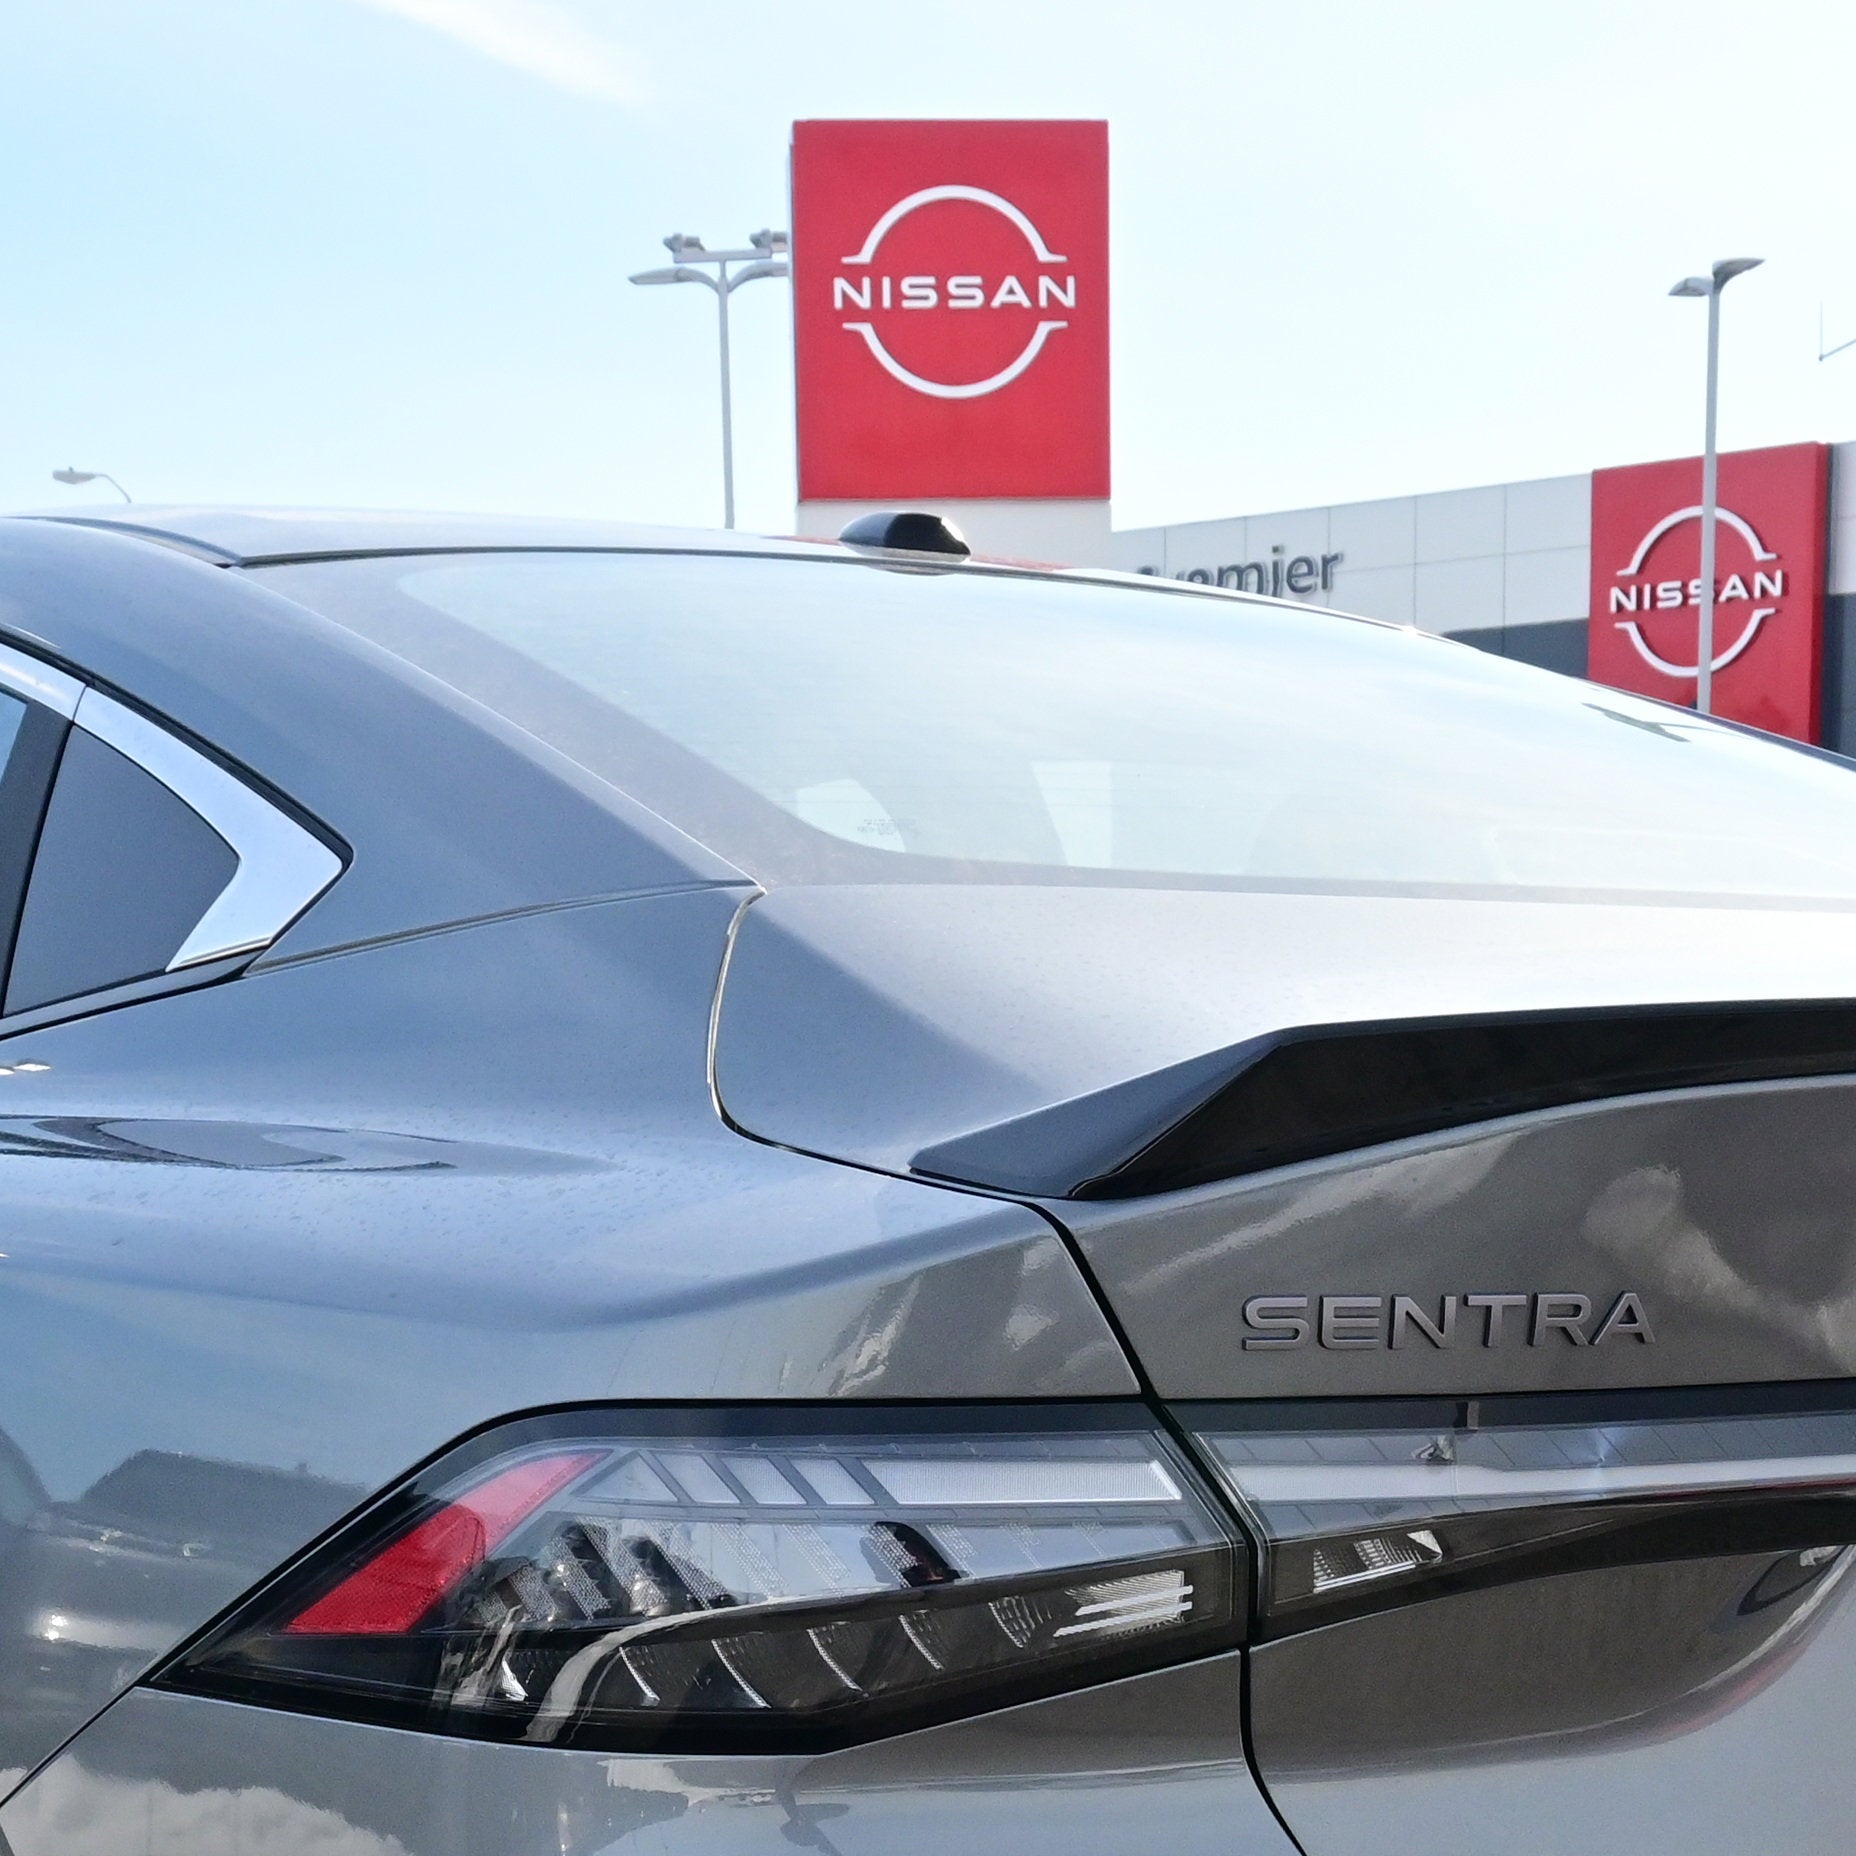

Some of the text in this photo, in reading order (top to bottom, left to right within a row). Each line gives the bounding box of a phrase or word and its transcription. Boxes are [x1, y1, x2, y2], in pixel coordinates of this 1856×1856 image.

[833, 275, 1076, 310] NISSAN
[1138, 544, 1344, 598] mier
[1610, 569, 1782, 613] NISSAN
[1242, 1291, 1656, 1351] SENTRA
